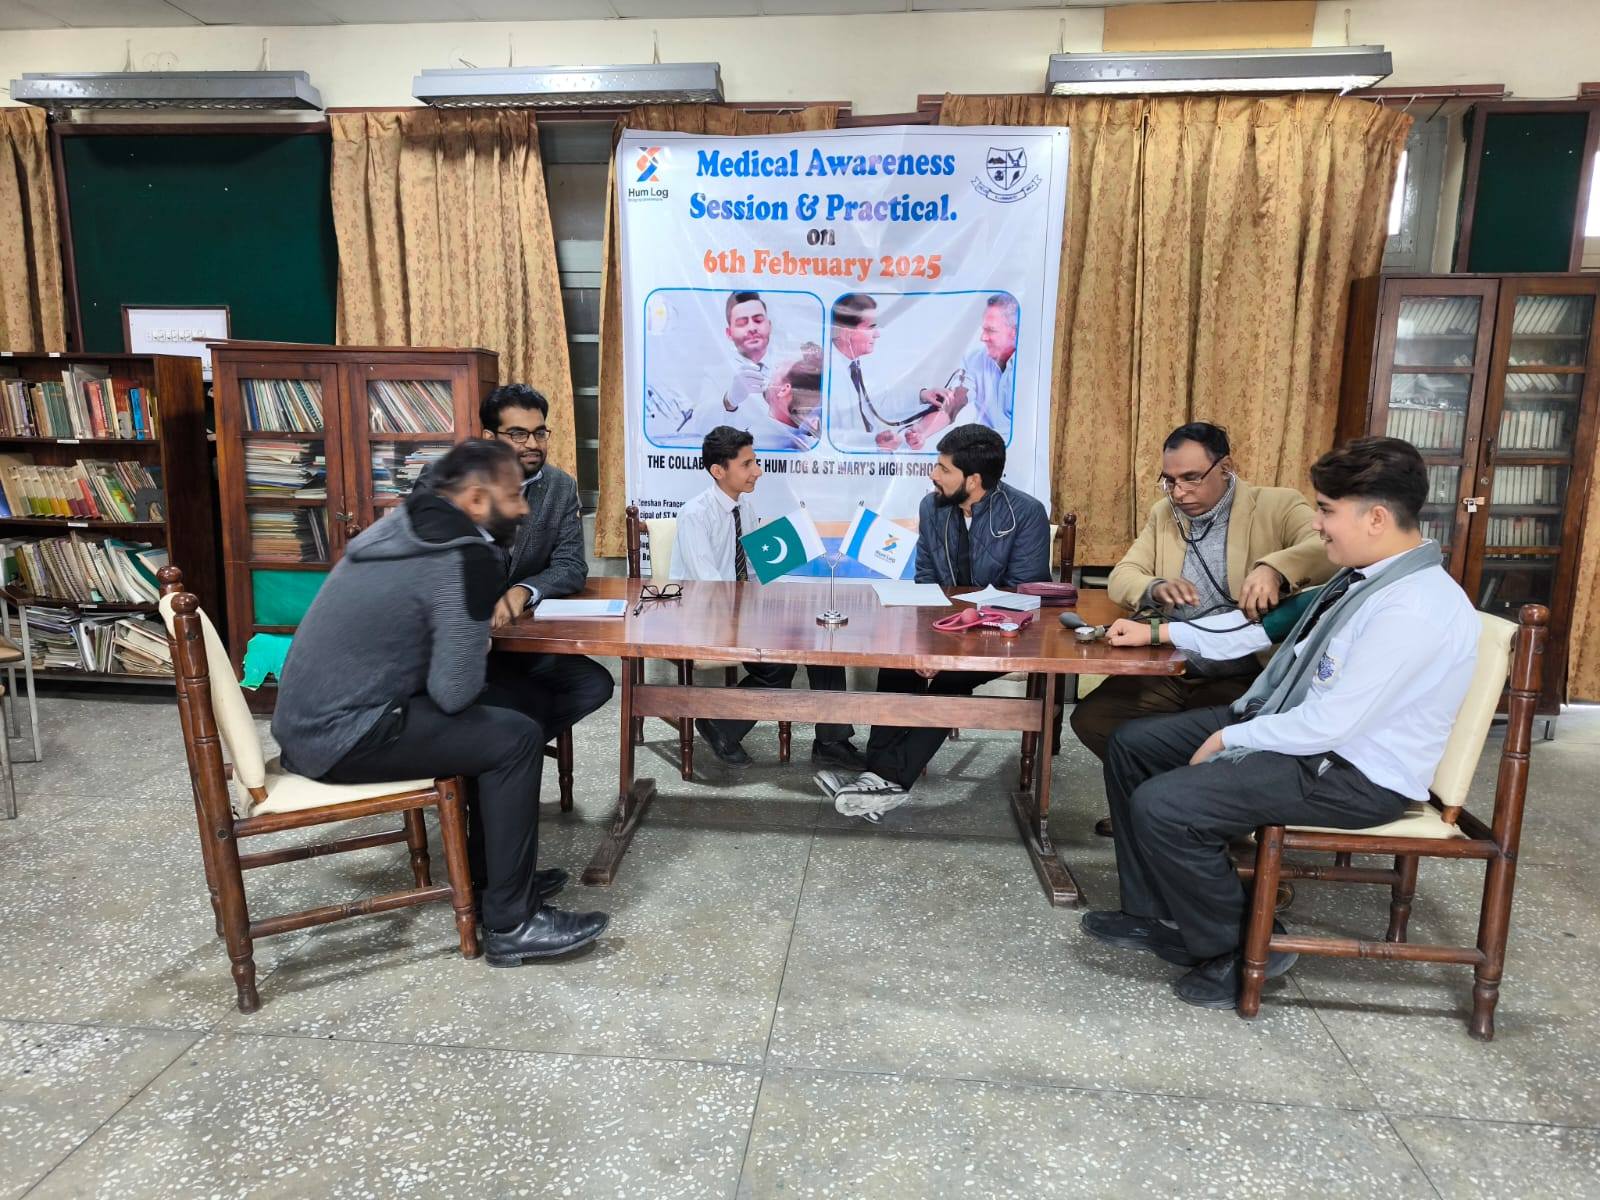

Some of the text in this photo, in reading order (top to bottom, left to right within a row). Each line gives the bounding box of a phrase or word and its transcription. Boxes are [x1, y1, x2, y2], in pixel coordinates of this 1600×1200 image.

[696, 148, 955, 177] Medical Awareness
[628, 187, 669, 199] Hum Log
[690, 192, 957, 221] Session & Practical.
[807, 228, 836, 246] on
[703, 248, 942, 282] 6th February 2025
[648, 455, 665, 469] THE
[764, 459, 787, 474] HUM
[790, 460, 809, 474] LOG
[811, 460, 819, 475] &
[822, 461, 835, 475] ST
[838, 462, 875, 476] MARY'S
[878, 462, 903, 476] HIGH
